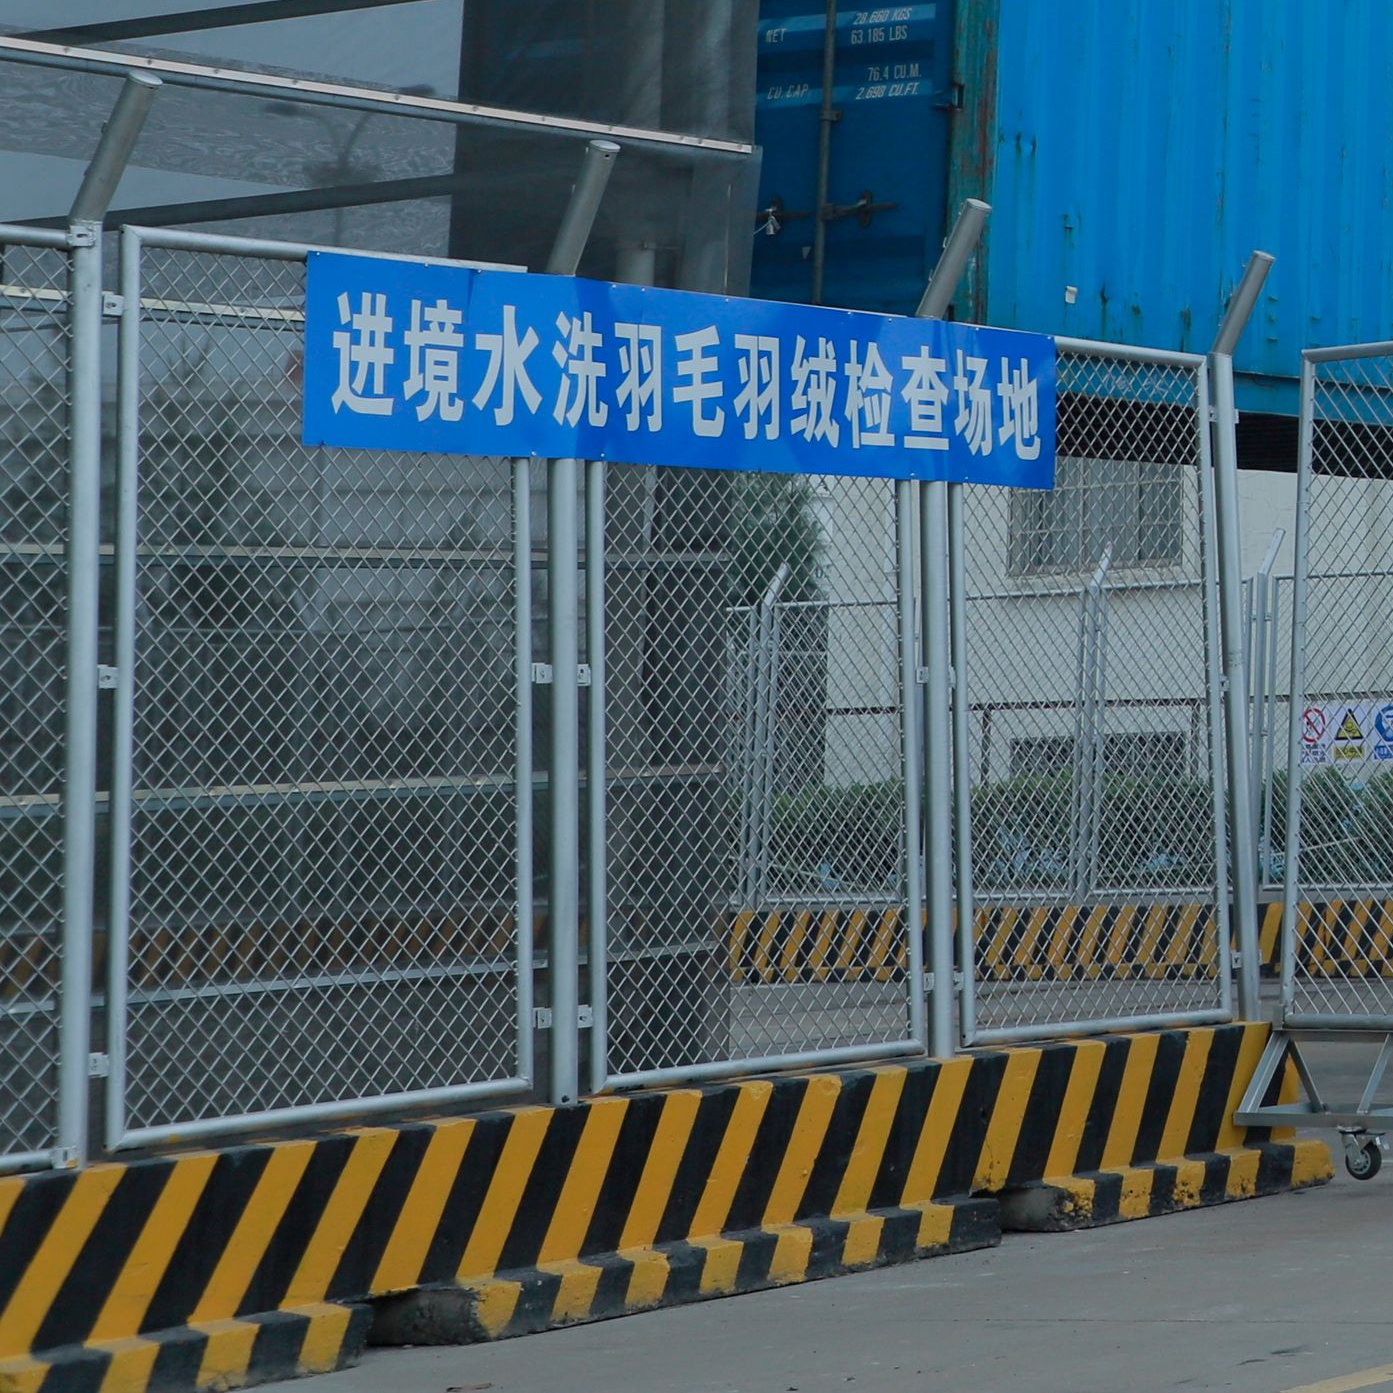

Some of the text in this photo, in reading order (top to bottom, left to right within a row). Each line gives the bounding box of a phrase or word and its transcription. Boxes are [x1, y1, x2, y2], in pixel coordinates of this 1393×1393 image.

[765, 28, 787, 43] NET
[890, 7, 913, 22] KGS
[889, 25, 908, 42] LBS
[867, 66, 890, 82] 76.4
[331, 291, 1042, 461] 进境水洗羽毛羽绒检查场地
